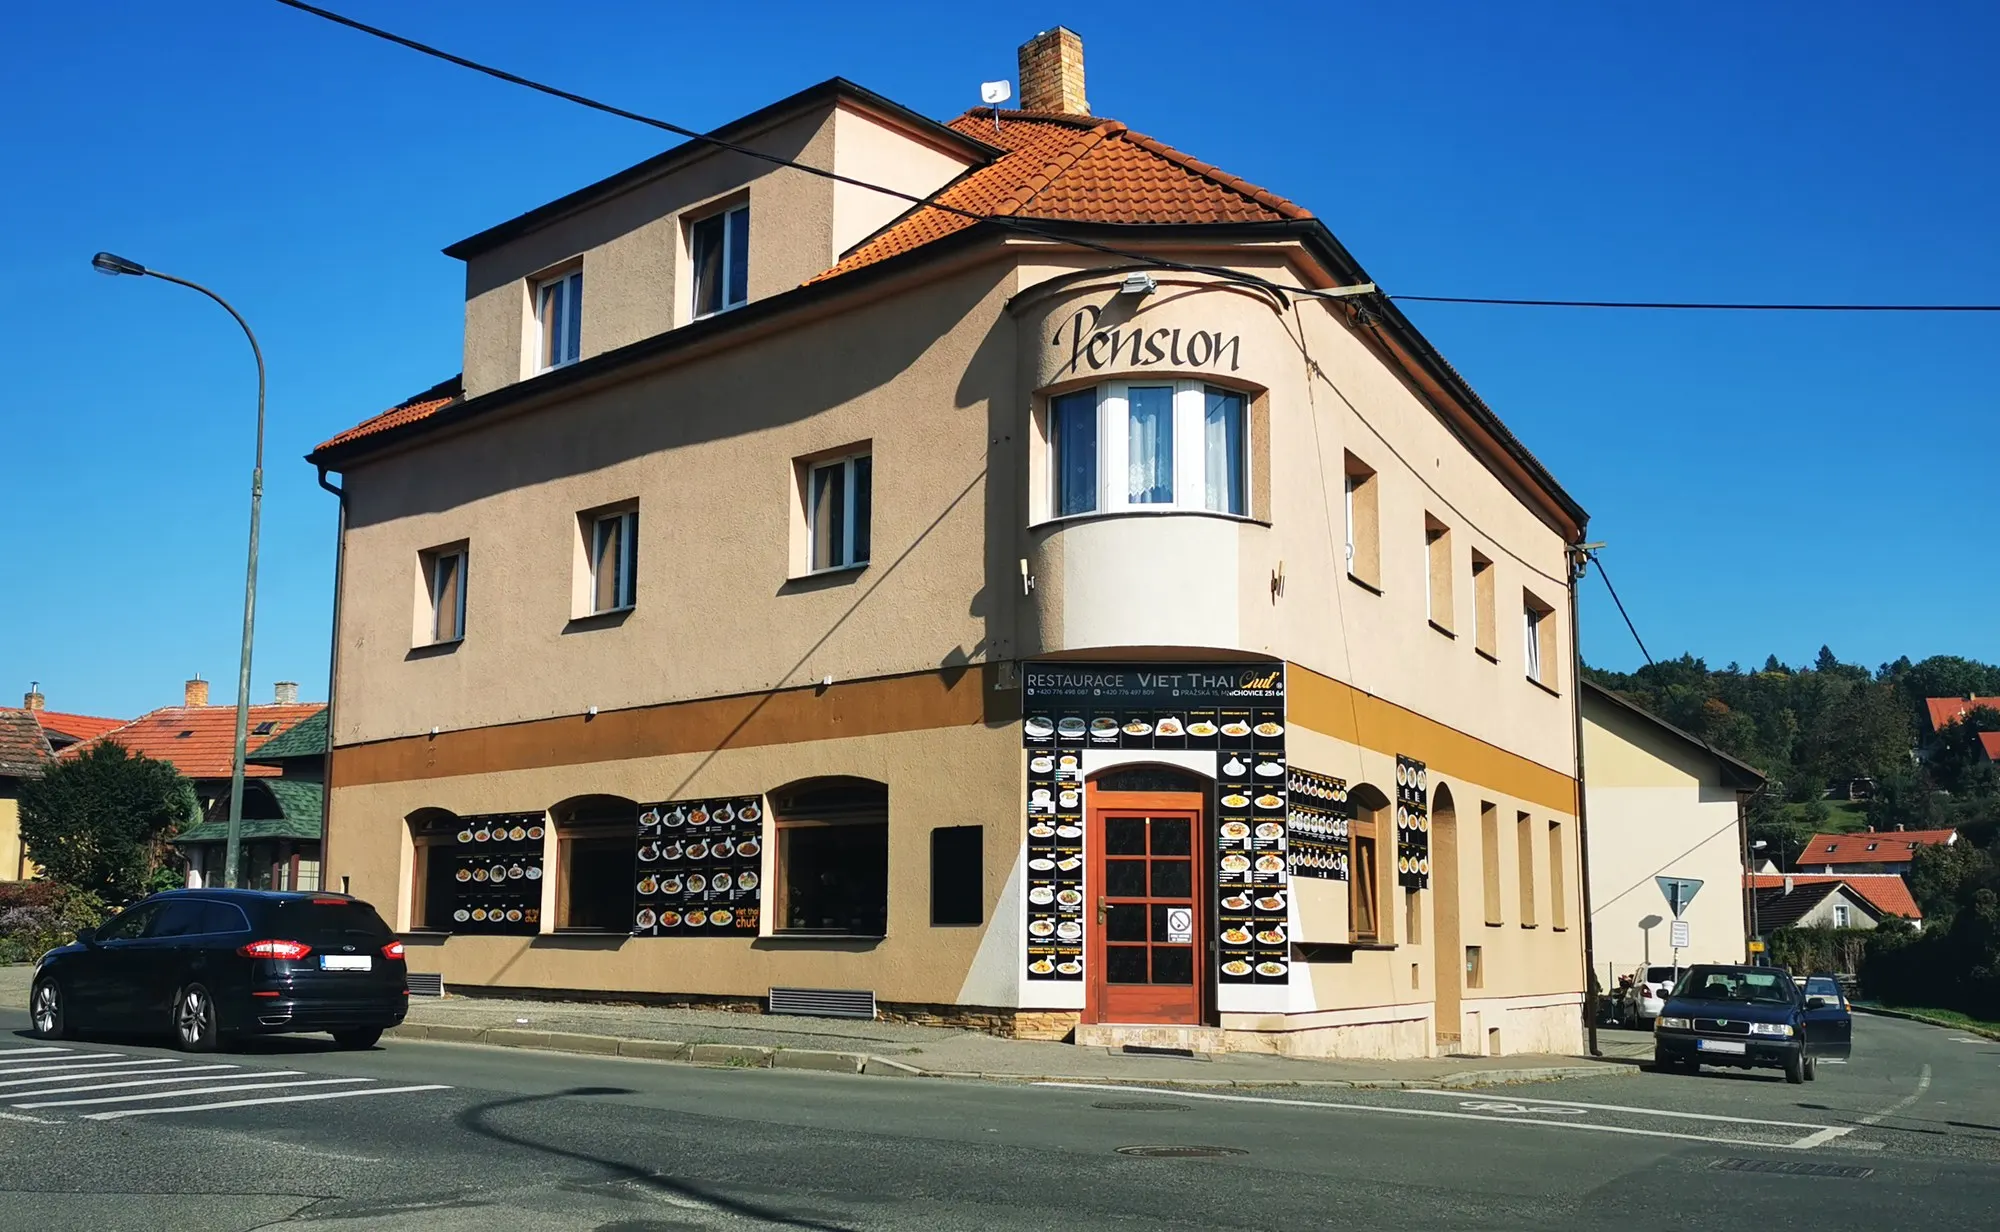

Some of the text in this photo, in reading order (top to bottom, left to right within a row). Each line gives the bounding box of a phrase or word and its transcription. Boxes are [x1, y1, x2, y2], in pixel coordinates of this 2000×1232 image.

[1052, 304, 1240, 374] Pension
[1027, 674, 1124, 687] RESTAURACE
[1136, 673, 1182, 688] VIET
[1187, 673, 1234, 688] THAI
[1275, 689, 1284, 697] 64
